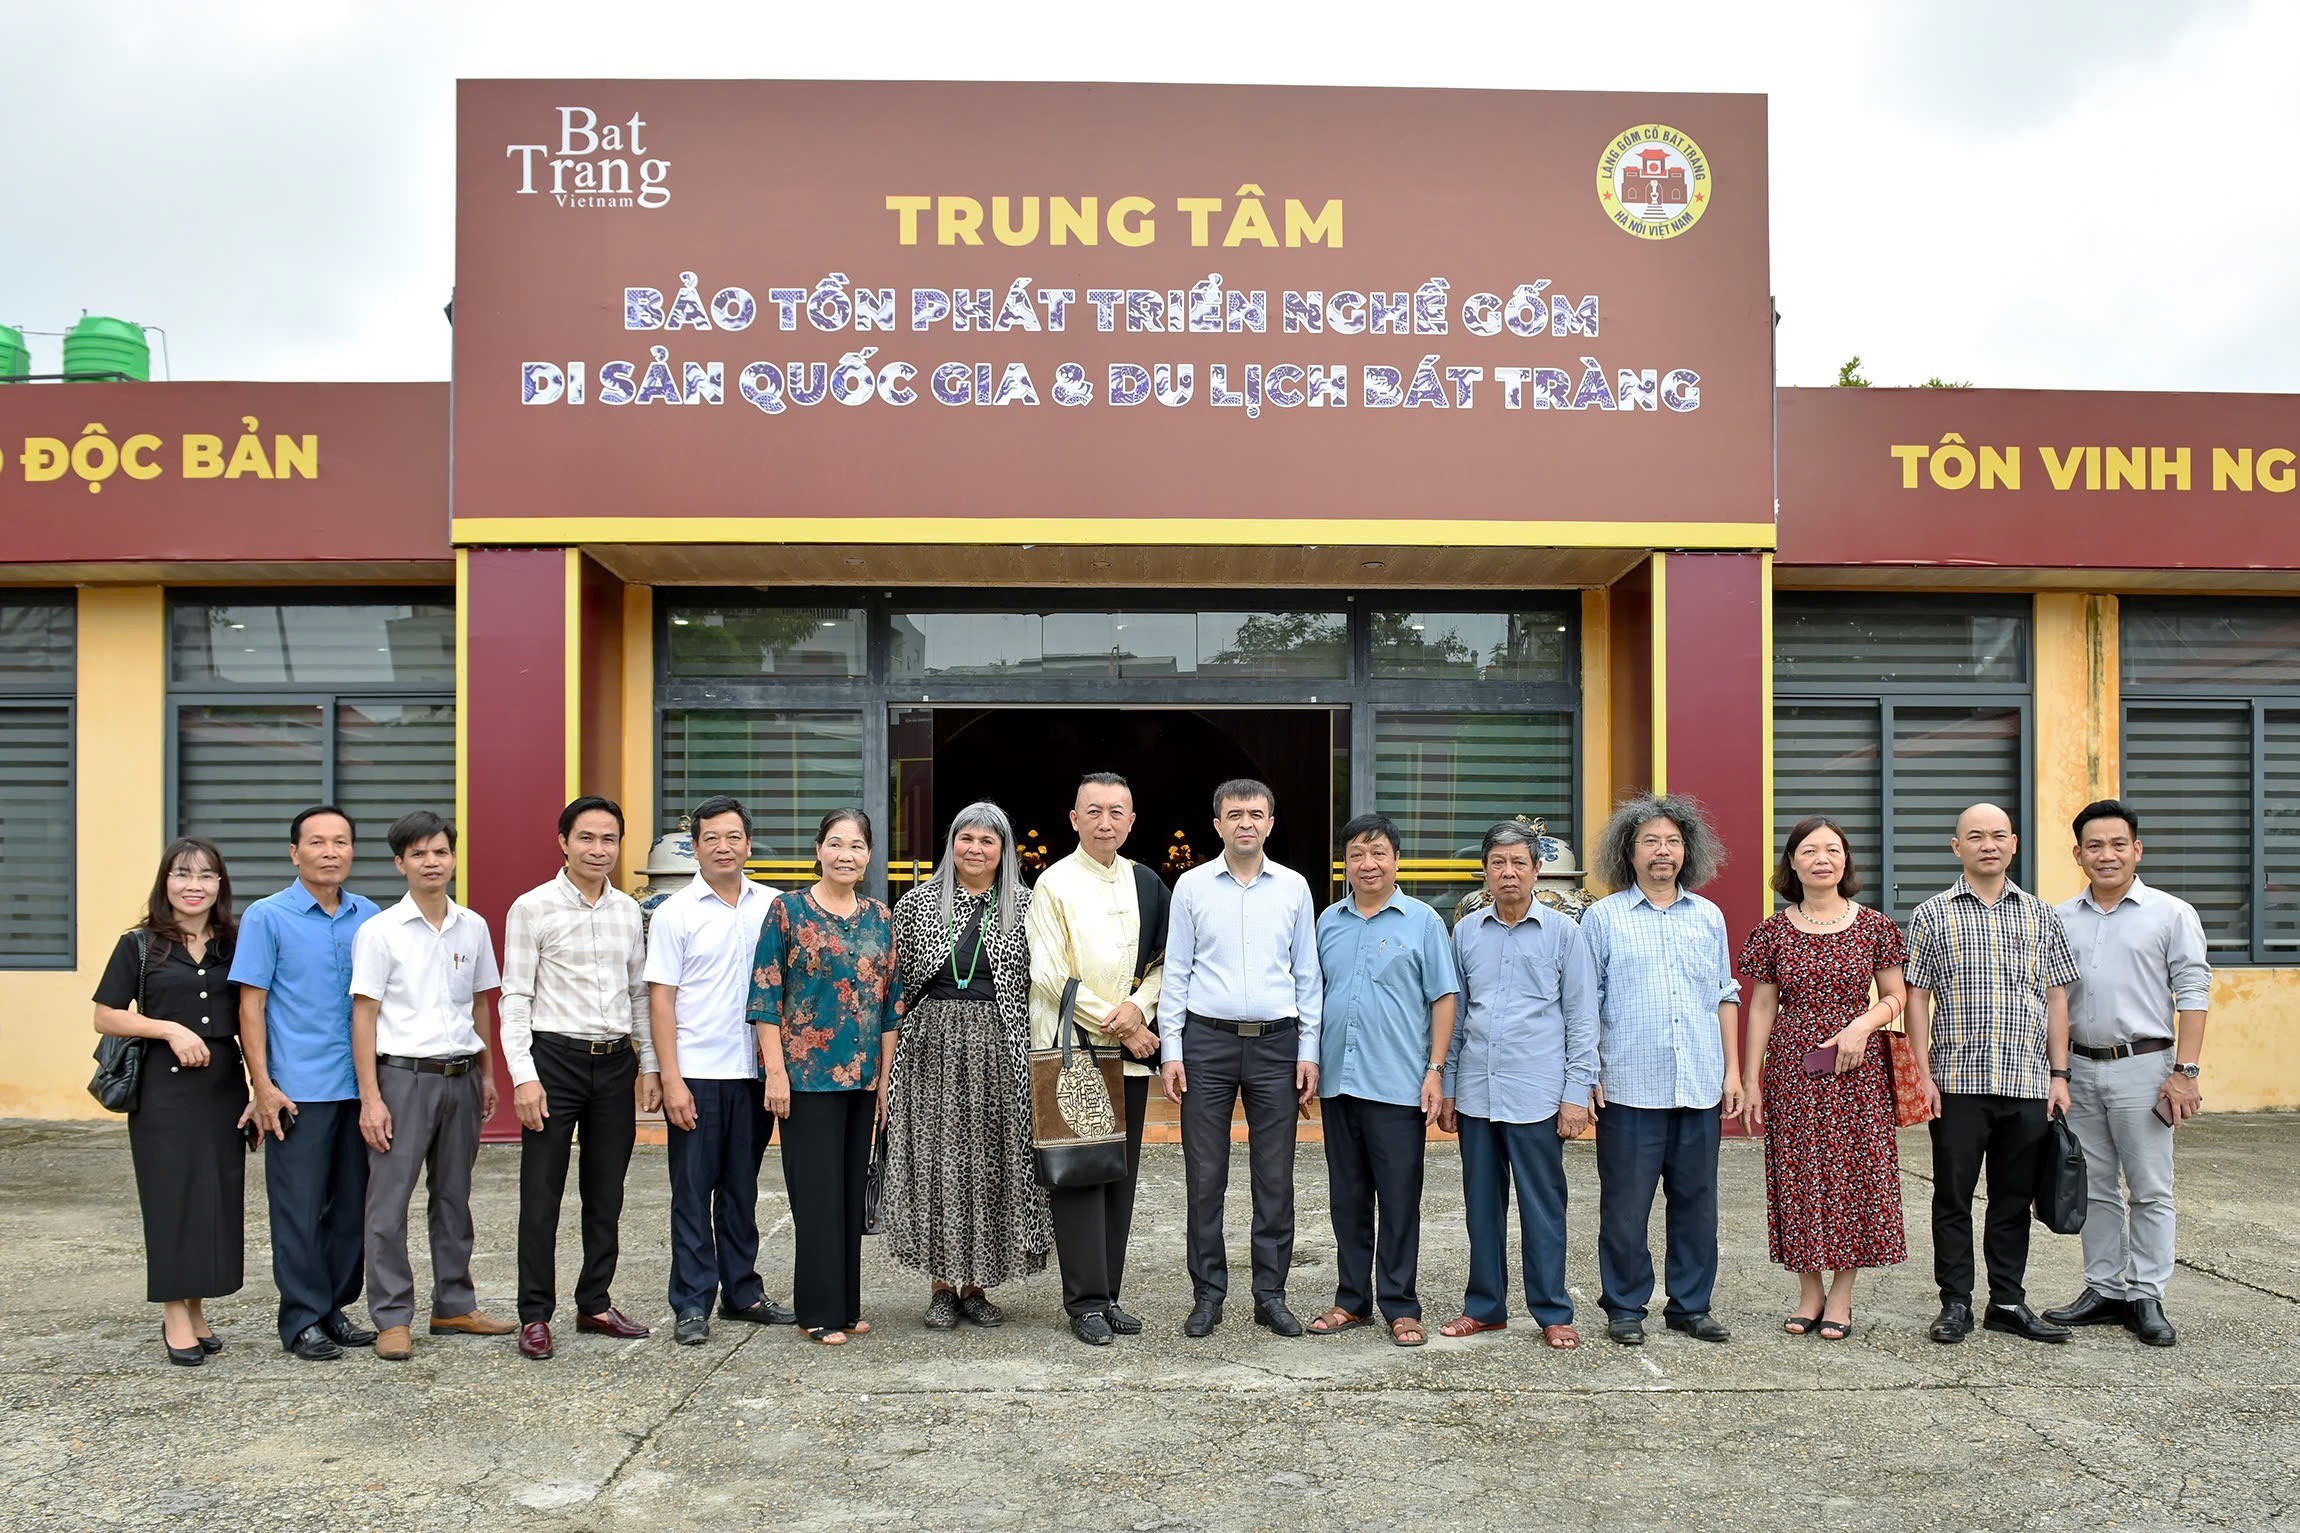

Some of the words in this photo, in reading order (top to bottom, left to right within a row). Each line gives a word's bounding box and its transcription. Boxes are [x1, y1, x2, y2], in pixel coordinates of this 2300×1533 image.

[555, 106, 647, 156] Bat
[1600, 149, 1620, 179] LÀNG
[1683, 144, 1706, 180] TRÀNG
[506, 144, 672, 208] Trang
[554, 194, 634, 208] Vietnam
[886, 195, 1156, 248] TRUNG
[1177, 183, 1344, 249] TÂM
[1614, 210, 1630, 226] HÀ
[1670, 212, 1694, 232] NAM
[623, 271, 757, 331] BẢO
[768, 272, 896, 332] TỒN
[911, 276, 1076, 332] PHÁT
[1086, 272, 1267, 333] TRIỂN
[1282, 277, 1451, 335] NGHỀ
[1461, 278, 1600, 338] GỐM
[521, 361, 586, 406] DI
[598, 344, 725, 406] SẢN
[738, 346, 919, 415] QUỐC
[930, 361, 1041, 407] GIA
[1051, 362, 1094, 407] &
[1108, 362, 1195, 408] DU
[1209, 363, 1348, 419] LỊCH
[1363, 354, 1484, 409] BÁT
[1494, 356, 1702, 413] TRÀNG
[20, 422, 163, 494] ĐỘC
[182, 415, 318, 479] BẢN
[1891, 432, 2021, 490] TÔN
[2038, 446, 2191, 491] VINH
[2212, 447, 2297, 493] NG
